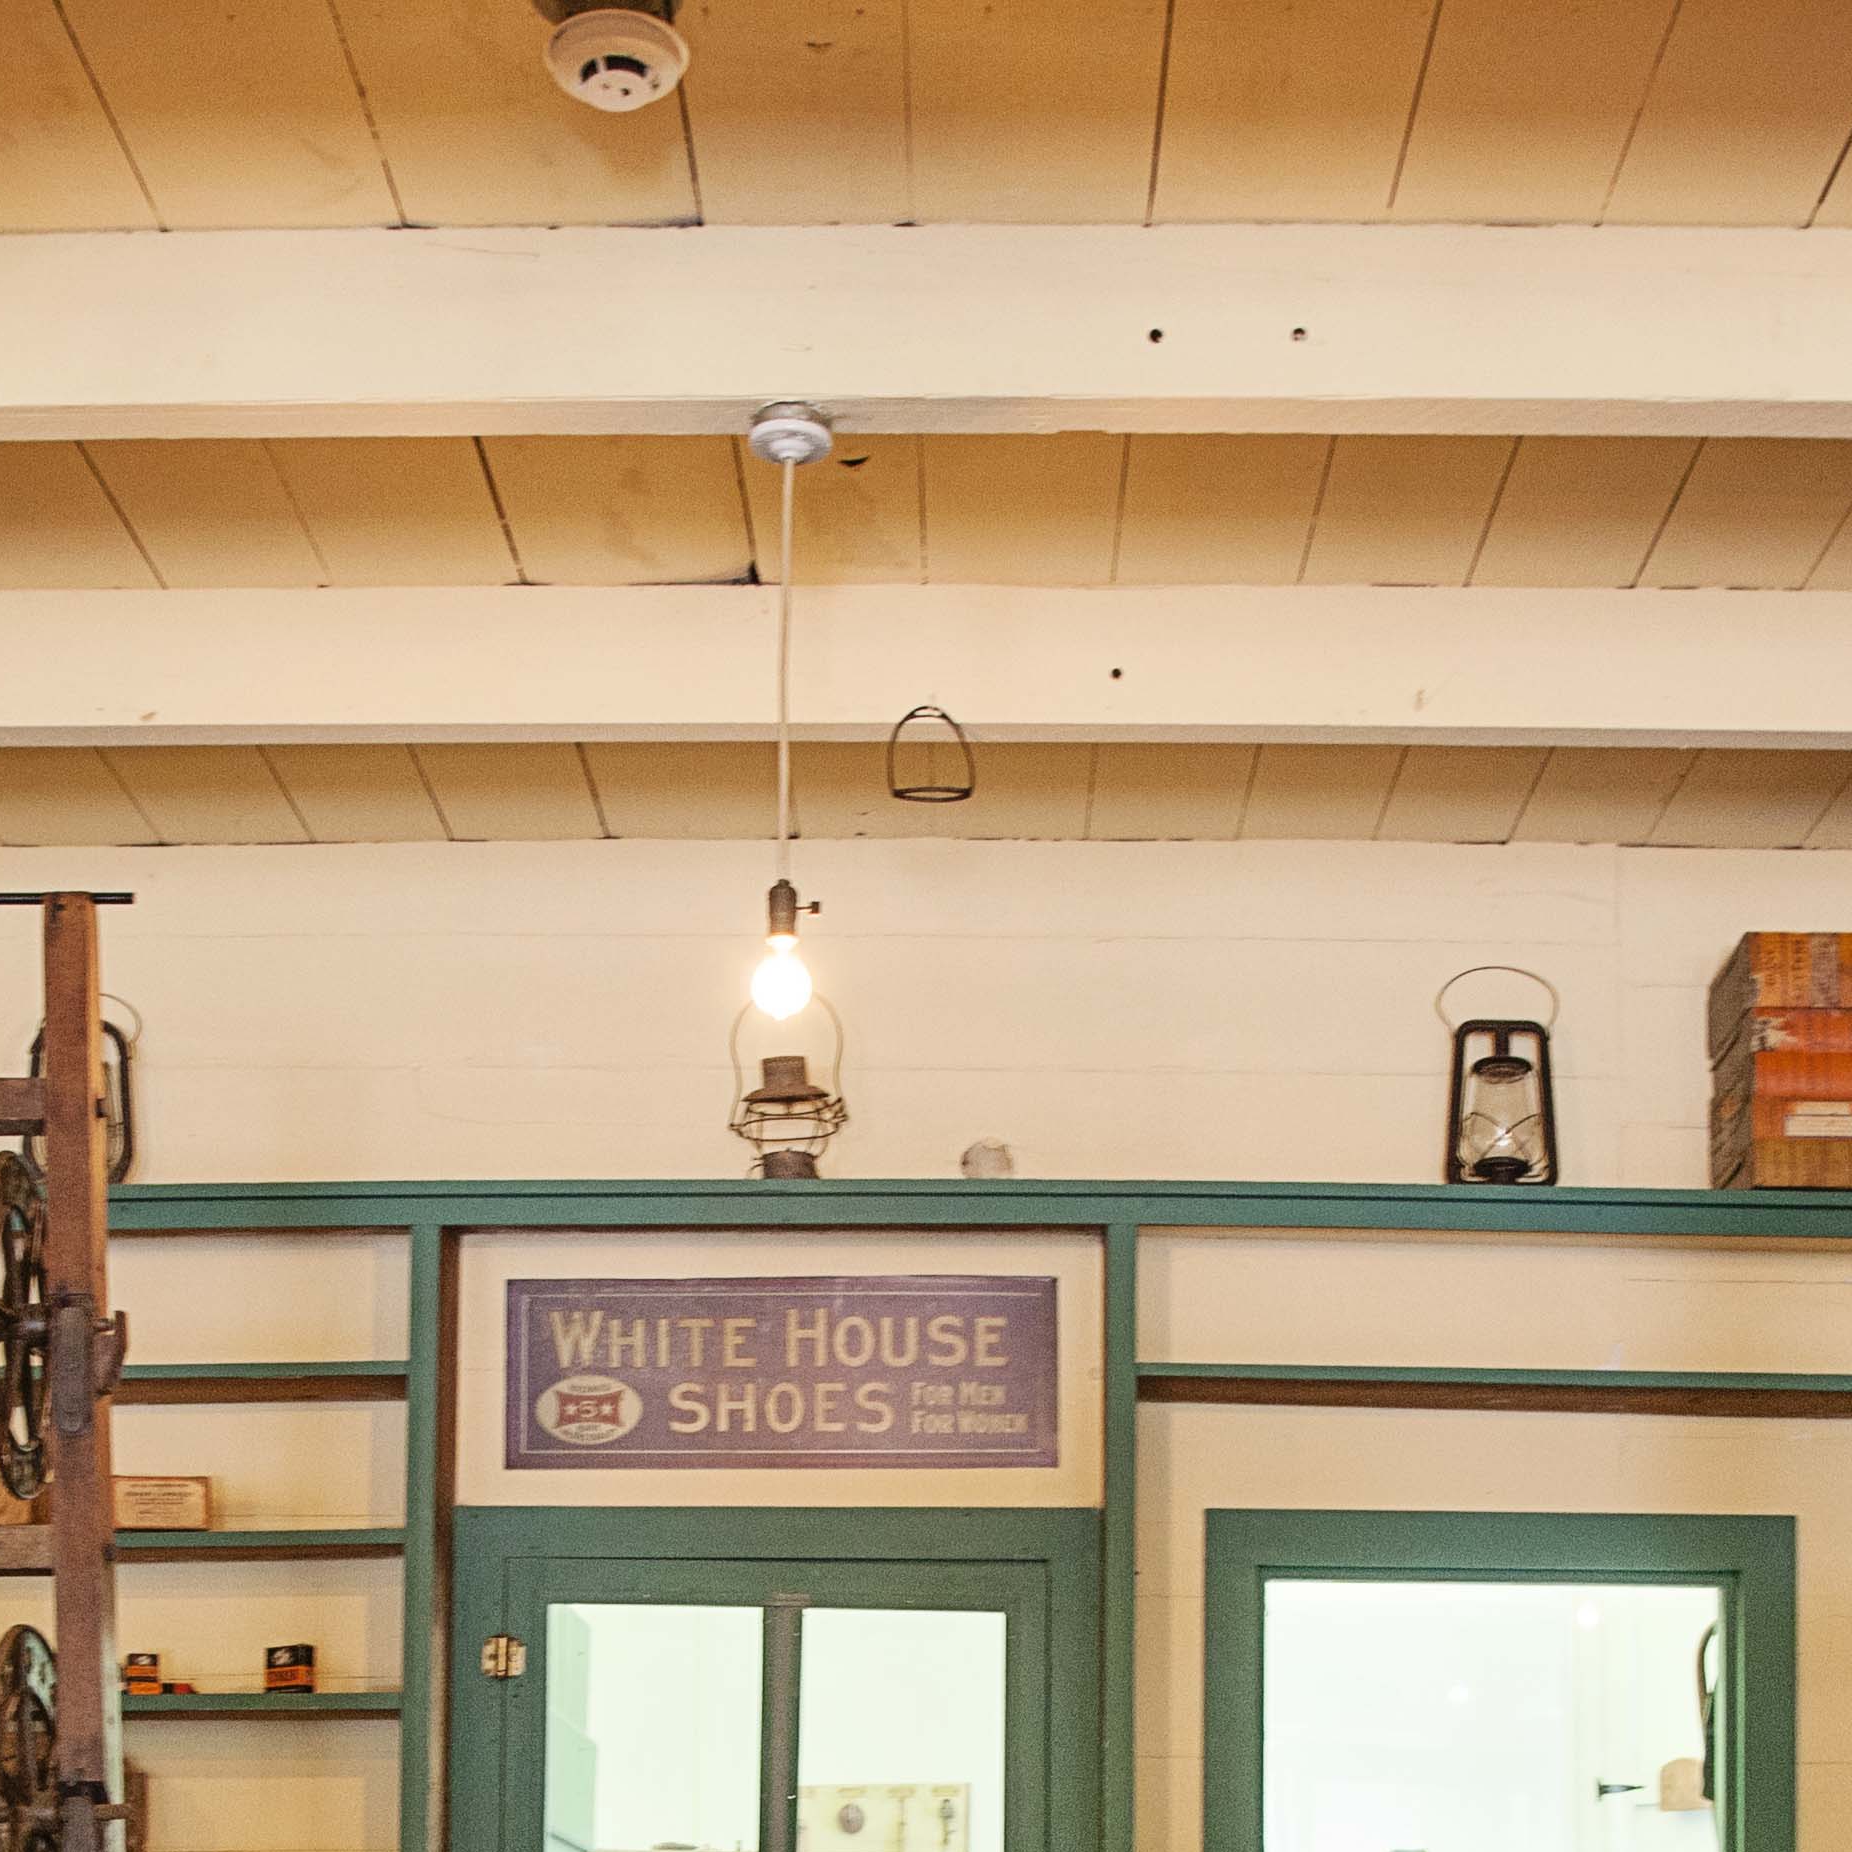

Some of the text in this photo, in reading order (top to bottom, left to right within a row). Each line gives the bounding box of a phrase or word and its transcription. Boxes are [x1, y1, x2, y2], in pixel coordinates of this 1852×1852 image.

[549, 1308, 1009, 1368] WHITE HOUSE
[668, 1381, 895, 1433] SHOES
